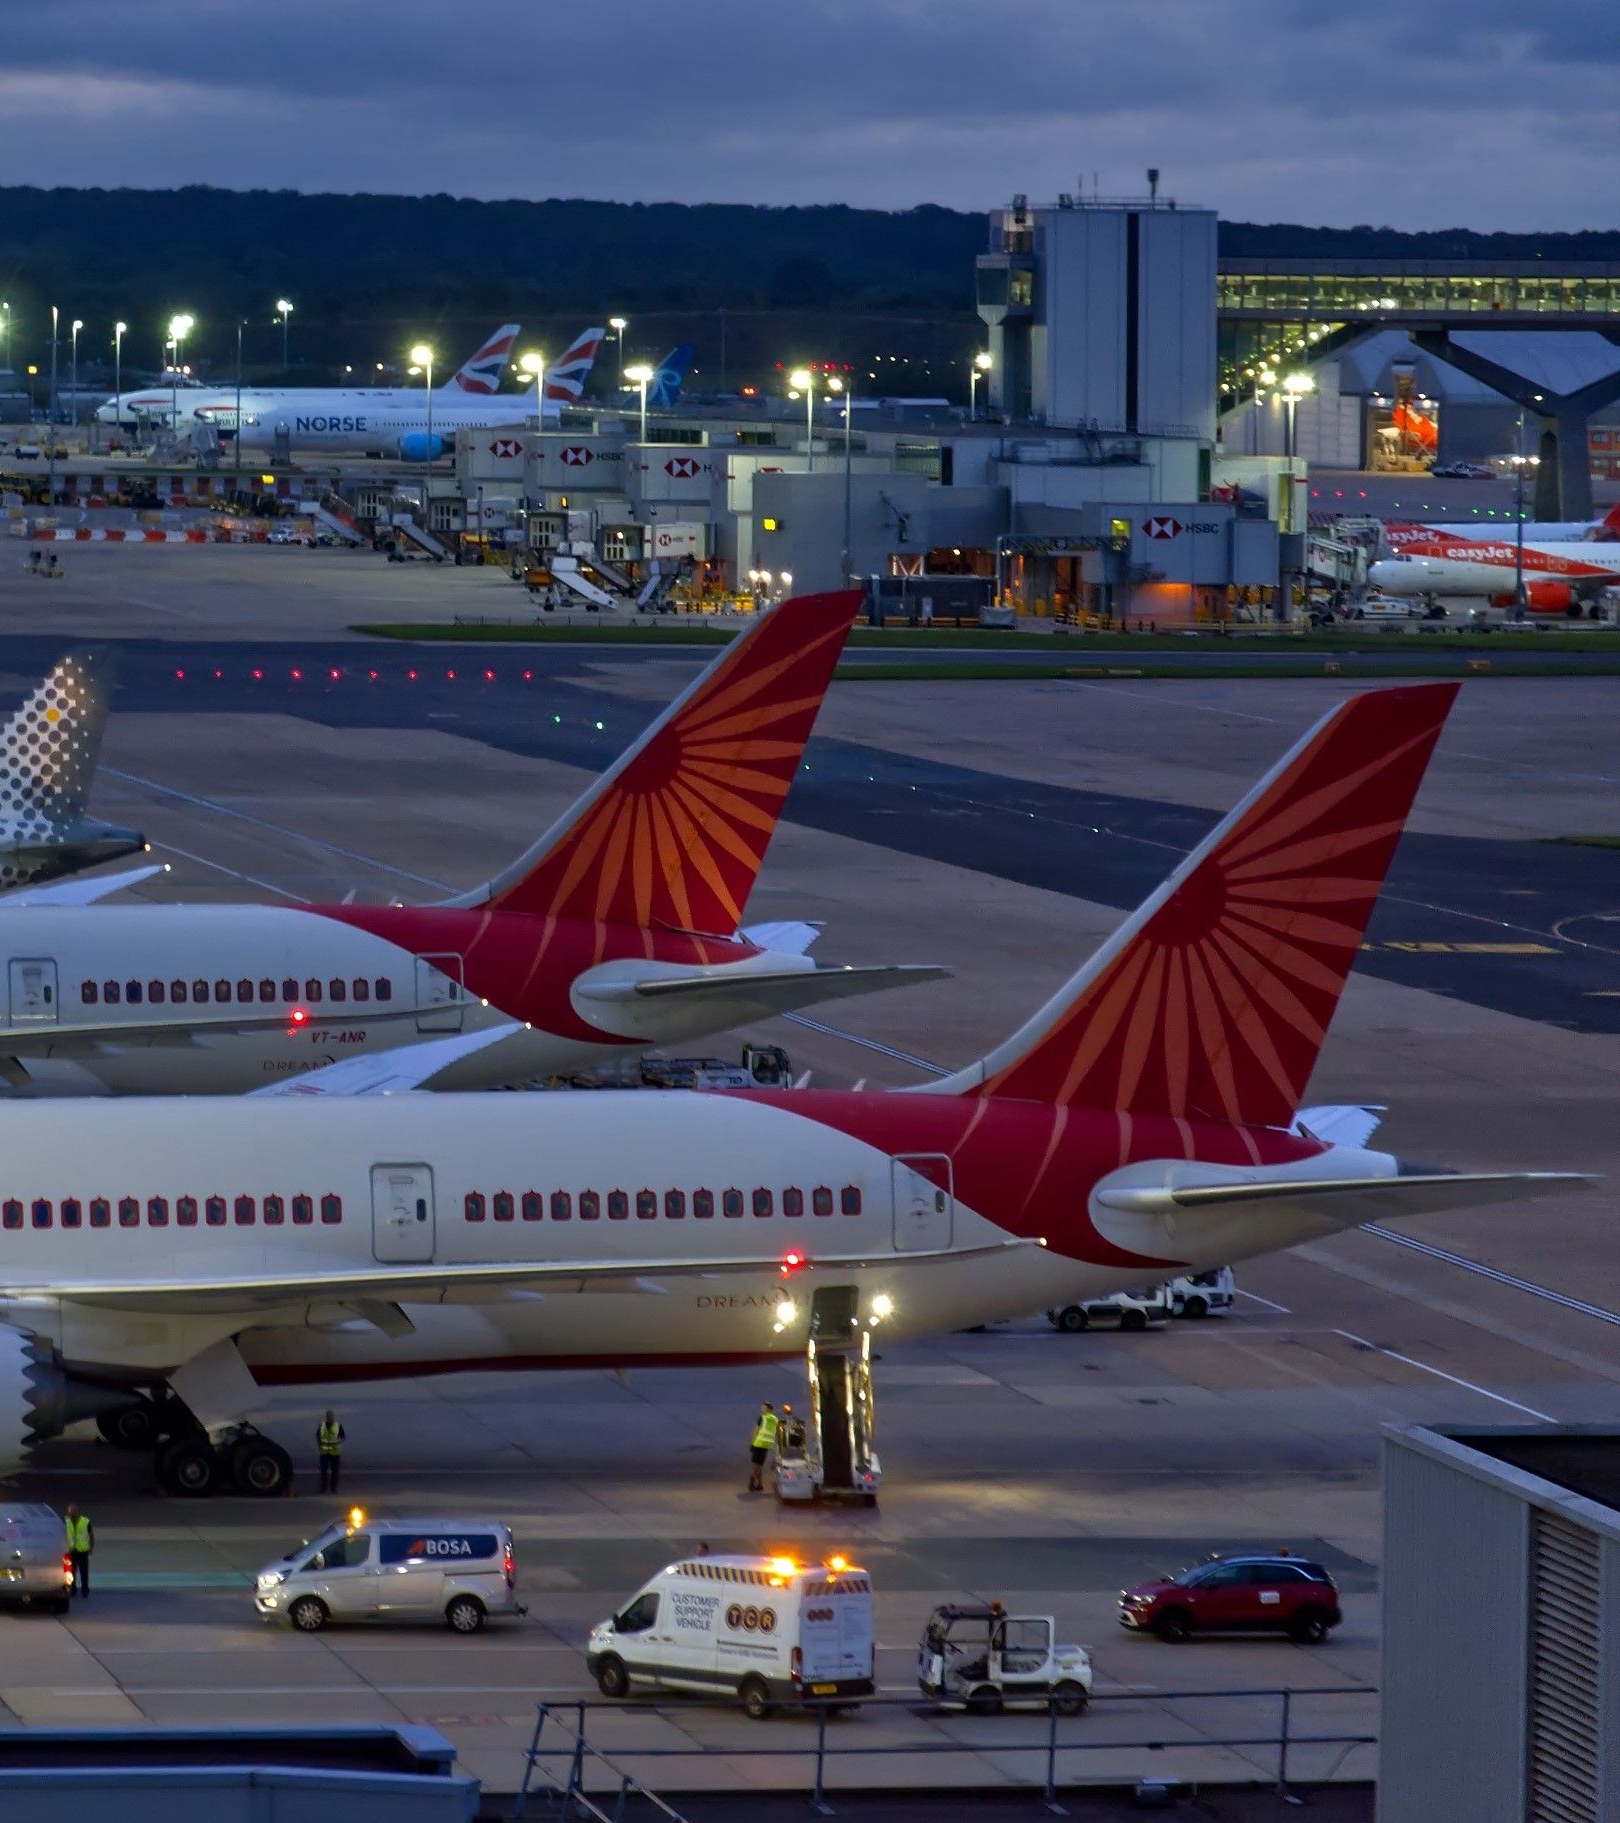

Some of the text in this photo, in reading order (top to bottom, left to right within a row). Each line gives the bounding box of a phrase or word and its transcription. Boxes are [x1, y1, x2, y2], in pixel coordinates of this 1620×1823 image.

[295, 415, 368, 432] NORSE
[1185, 523, 1220, 534] HSBC
[1446, 547, 1514, 561] easyJet
[311, 1031, 367, 1044] VT-ANR
[426, 1539, 472, 1555] BOSA
[671, 1592, 720, 1608] CUSTOMER
[674, 1605, 715, 1620] SUPPORT
[728, 1609, 775, 1631] TCR
[675, 1617, 712, 1632] VEHICLE
